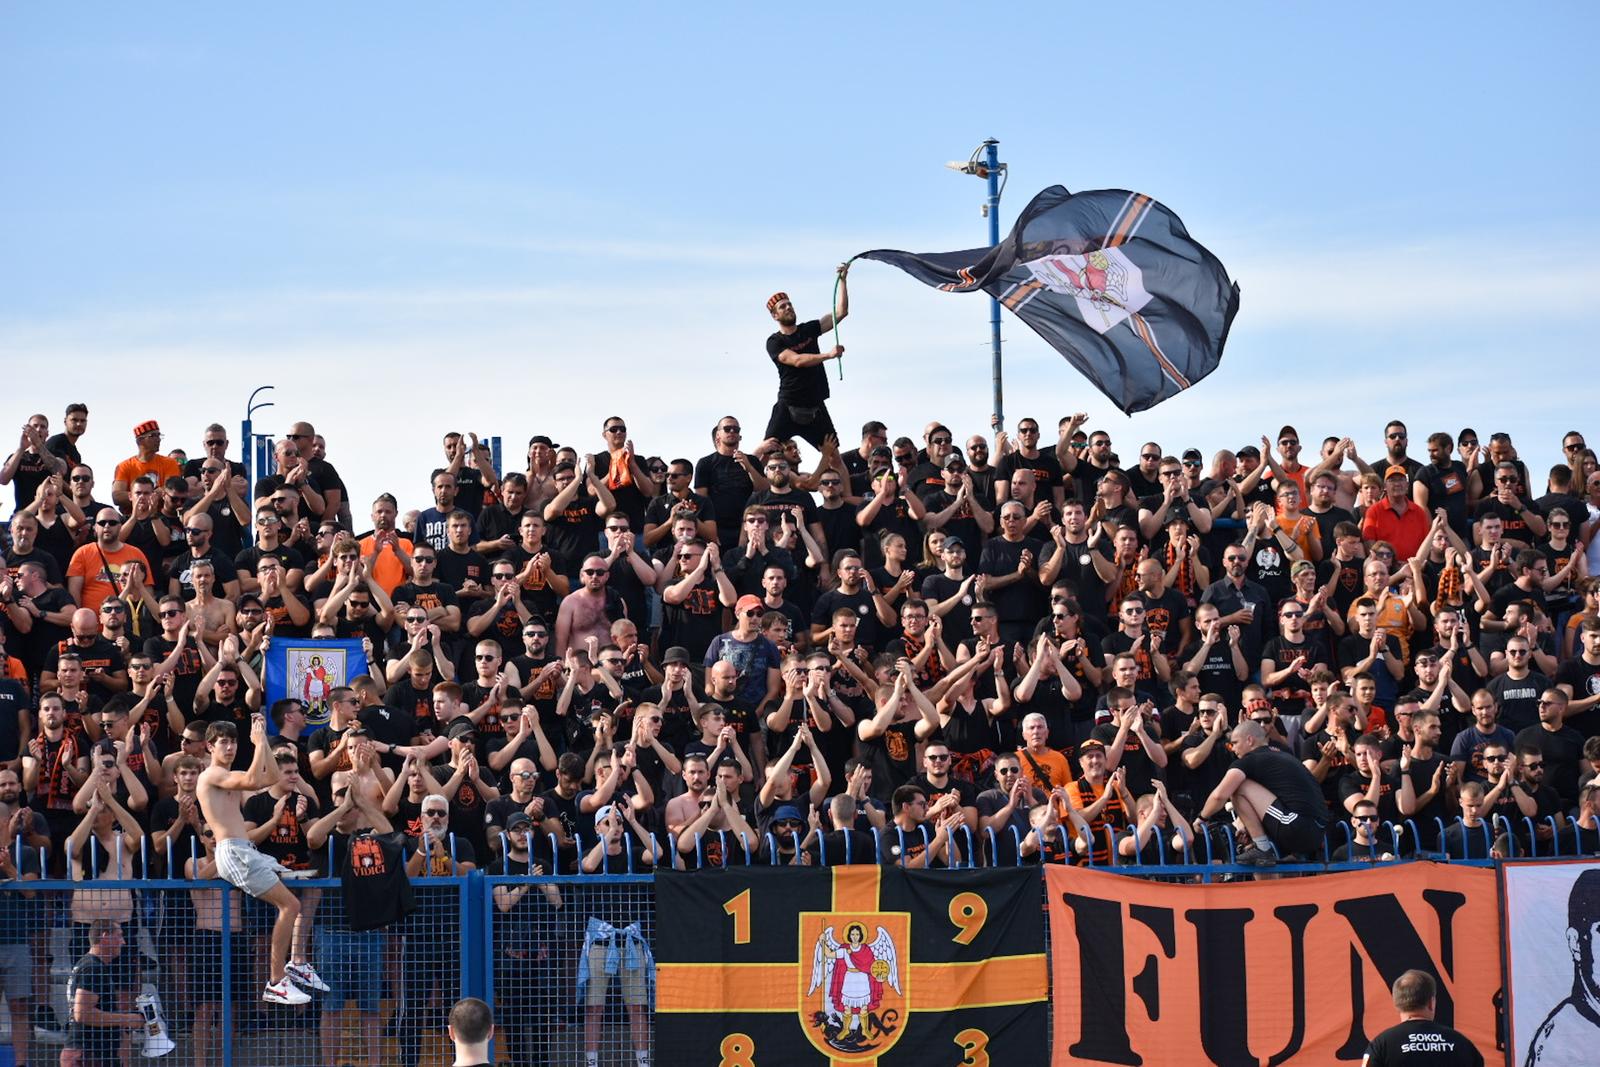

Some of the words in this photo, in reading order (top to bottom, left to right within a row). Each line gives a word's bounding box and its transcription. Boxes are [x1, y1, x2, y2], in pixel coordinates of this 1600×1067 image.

[352, 864, 386, 878] VIDICI
[722, 887, 751, 945] 1
[947, 890, 989, 946] 9
[1408, 1033, 1446, 1042] SOKOL
[952, 1027, 990, 1067] 3
[1400, 1042, 1455, 1053] SECURITY
